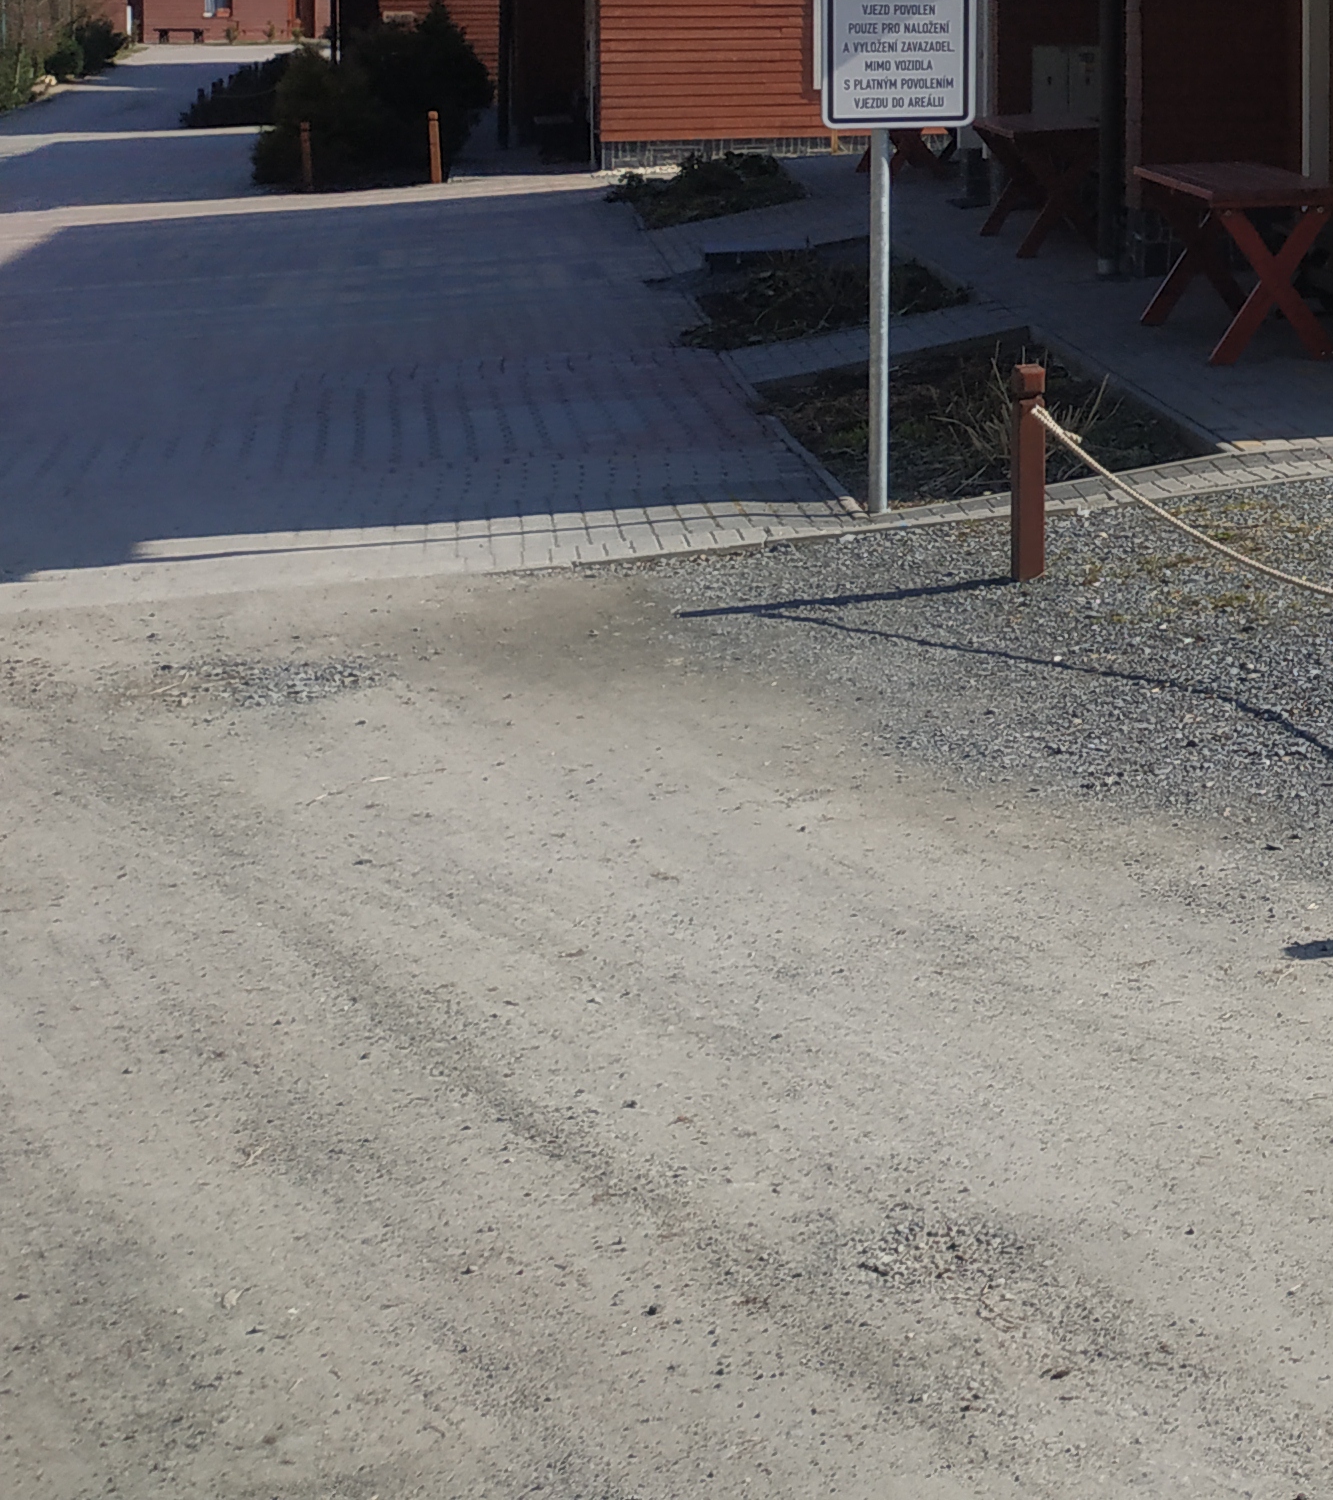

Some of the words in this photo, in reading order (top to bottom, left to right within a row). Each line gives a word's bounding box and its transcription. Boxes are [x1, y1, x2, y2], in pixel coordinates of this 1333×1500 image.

[862, 4, 890, 16] VJEZD
[894, 4, 936, 16] POVOLEN
[848, 22, 878, 34] POUZE
[882, 23, 900, 34] PRO
[904, 20, 950, 34] NALOŽENÍ
[843, 42, 850, 53] A
[853, 39, 898, 53] VYLOŽENÍ
[865, 60, 891, 71] MIMO
[895, 59, 933, 71] VOZIDLA
[844, 79, 850, 90] S
[854, 76, 897, 90] PLATNÝM
[901, 75, 954, 89] POVOLENÍM
[854, 97, 889, 109] VJEZDU
[892, 97, 904, 108] DO
[908, 94, 944, 108] AREÁLU
